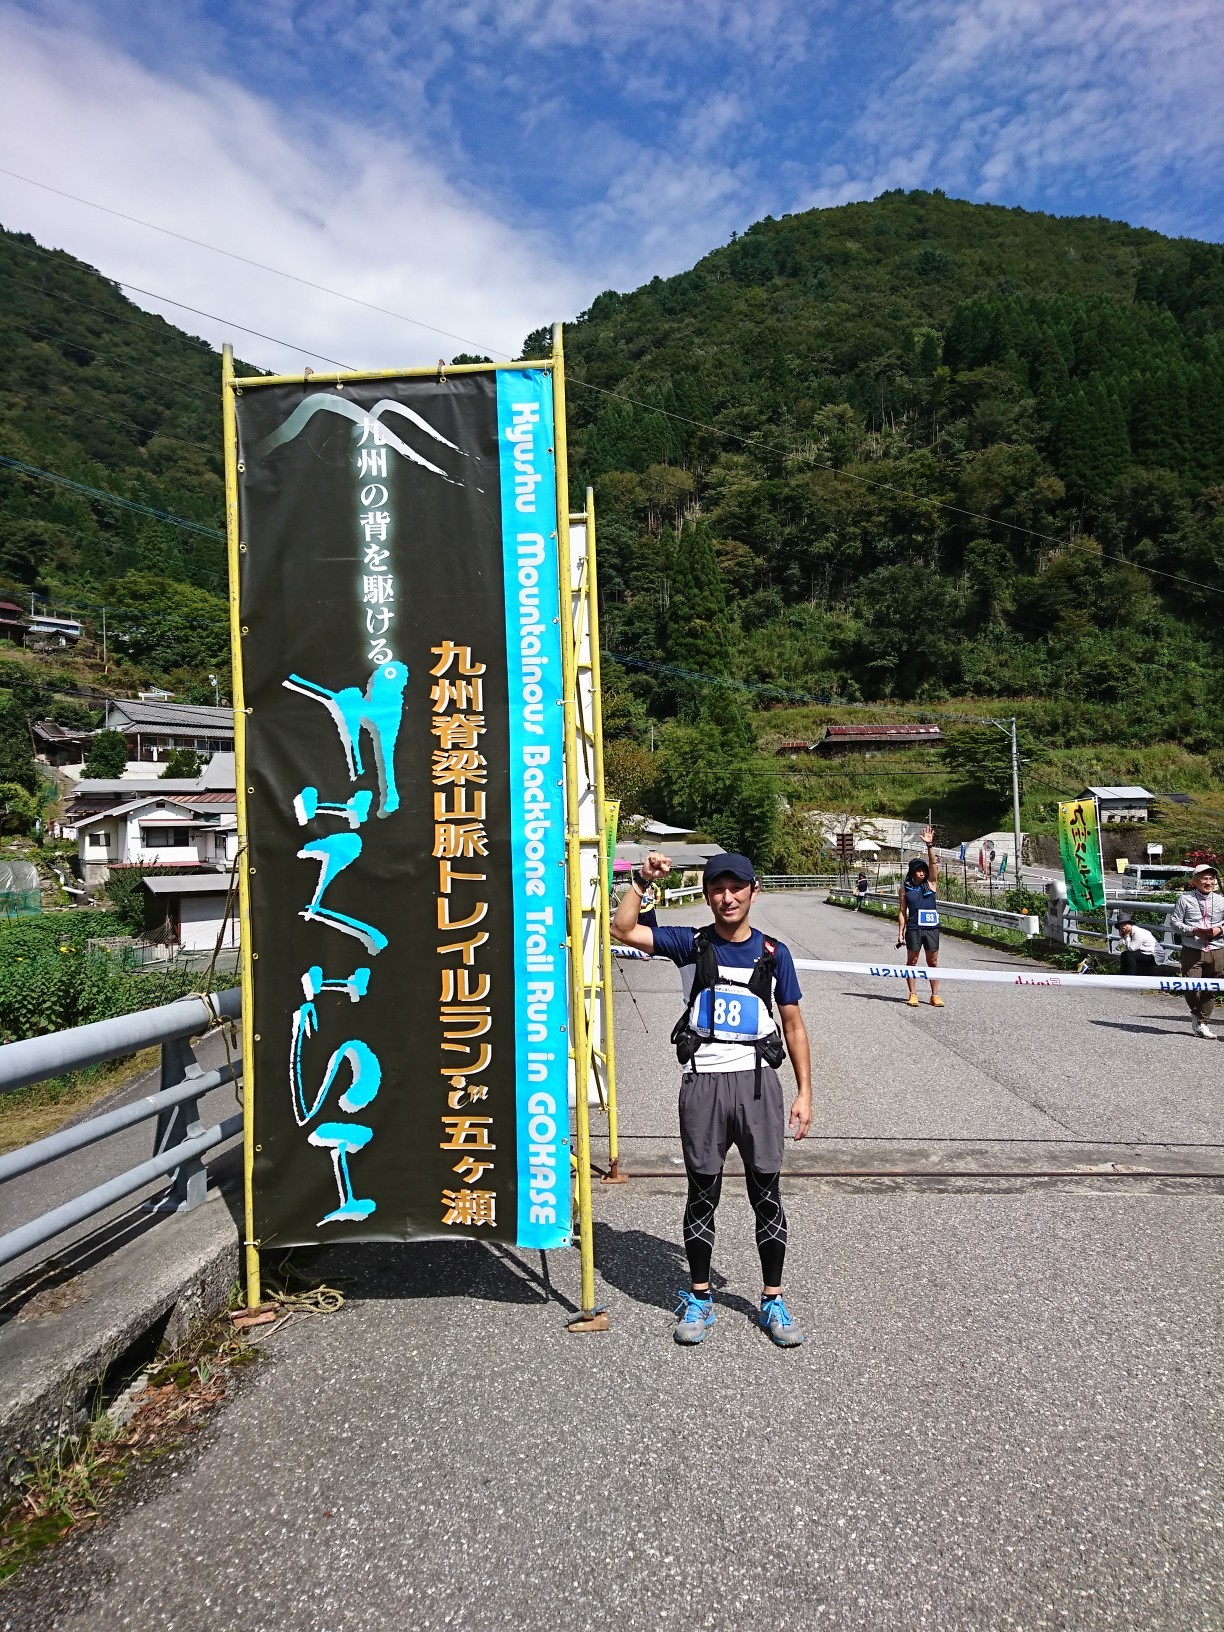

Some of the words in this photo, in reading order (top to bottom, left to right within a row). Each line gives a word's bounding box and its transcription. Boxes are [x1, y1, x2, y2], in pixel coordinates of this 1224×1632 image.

[506, 403, 542, 512] Kyushu
[356, 417, 396, 680] 九州の背を駆ける。
[517, 533, 547, 735] Mountainous
[523, 746, 550, 897] Backbone
[525, 907, 553, 972] Trail
[925, 913, 935, 922] 93
[526, 982, 554, 1041] Run
[713, 998, 742, 1027] 88
[528, 1053, 555, 1082] in
[529, 1092, 557, 1225] GOKASE
